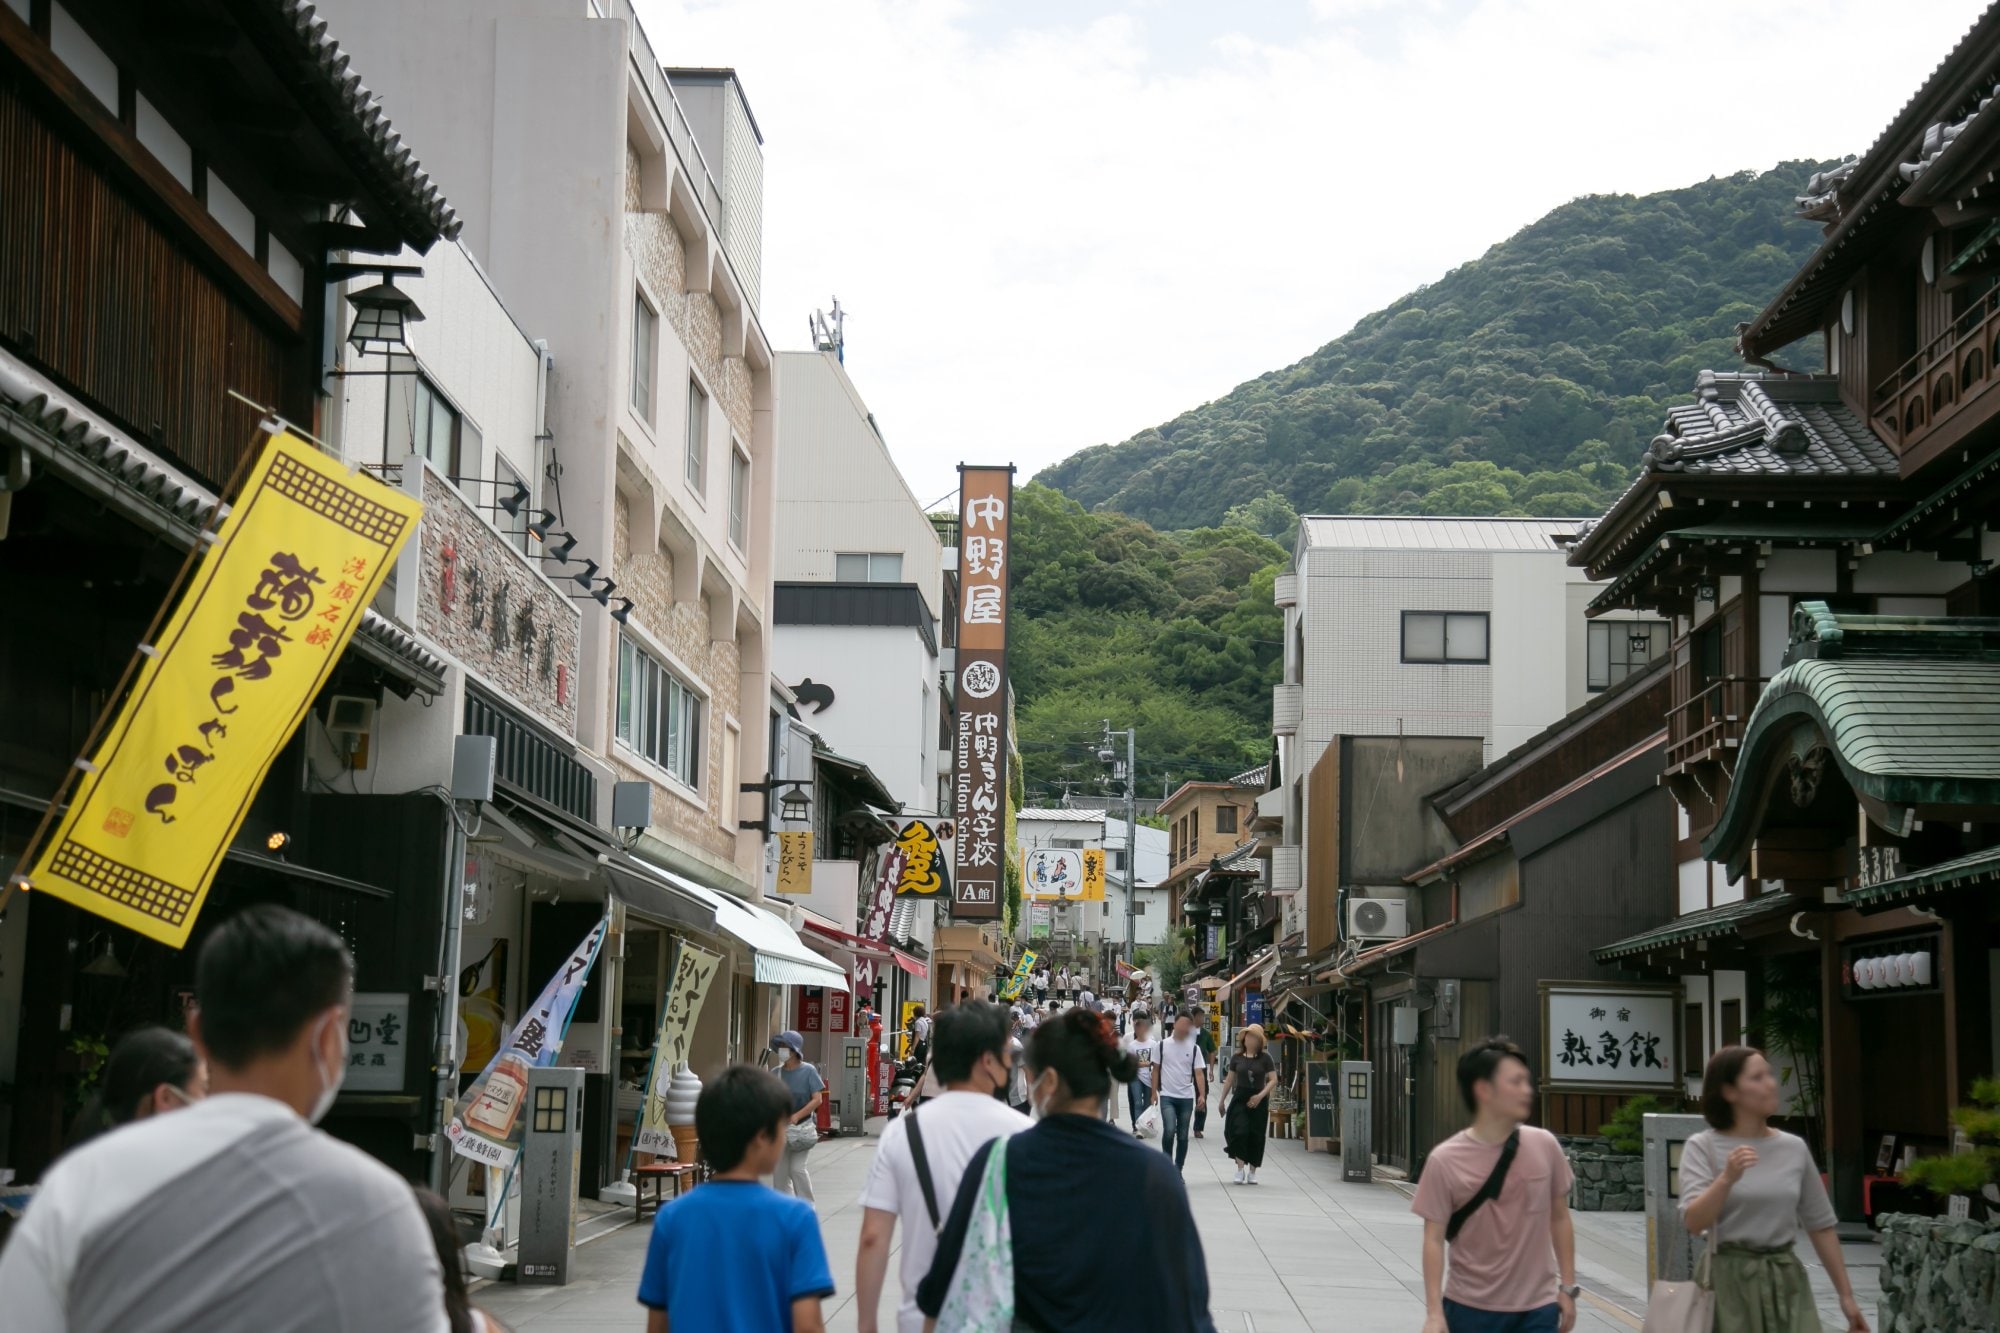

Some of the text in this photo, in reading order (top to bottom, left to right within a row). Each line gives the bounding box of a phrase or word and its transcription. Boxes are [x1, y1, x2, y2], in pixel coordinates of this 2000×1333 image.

[964, 494, 1005, 624] 中野屋
[957, 711, 973, 867] Nakano Udon School
[968, 711, 999, 868] 中野うどん学校
[797, 832, 808, 871] ようこそ
[961, 883, 991, 901] A館
[1589, 1006, 1631, 1022] 御宿
[1556, 1028, 1662, 1070] 敷島館
